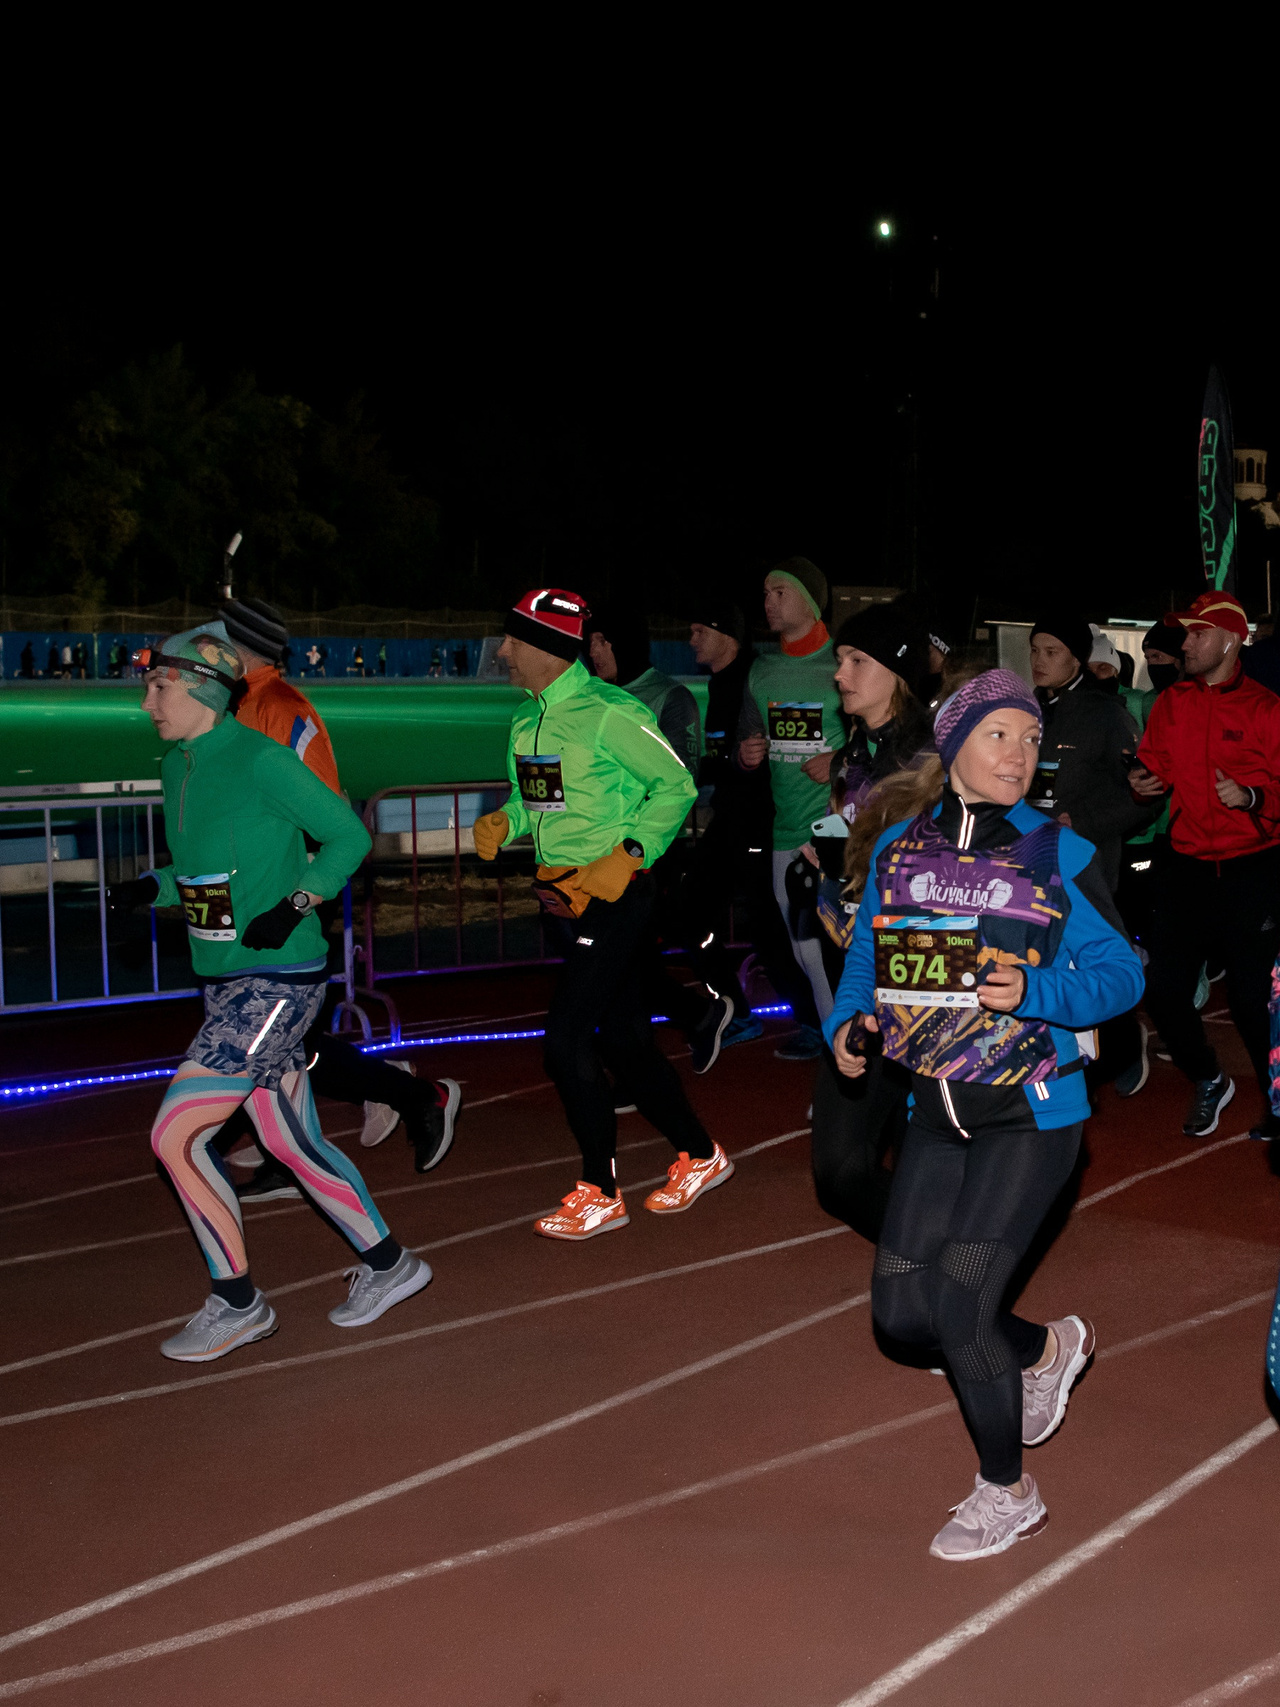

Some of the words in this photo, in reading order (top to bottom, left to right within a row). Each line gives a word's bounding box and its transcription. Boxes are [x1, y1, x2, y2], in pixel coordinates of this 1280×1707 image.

[929, 633, 950, 655] ORT
[776, 721, 808, 737] 692
[941, 880, 982, 888] CLUB
[928, 885, 989, 909] KUVALDA
[946, 936, 973, 946] 10km
[889, 953, 948, 985] 674
